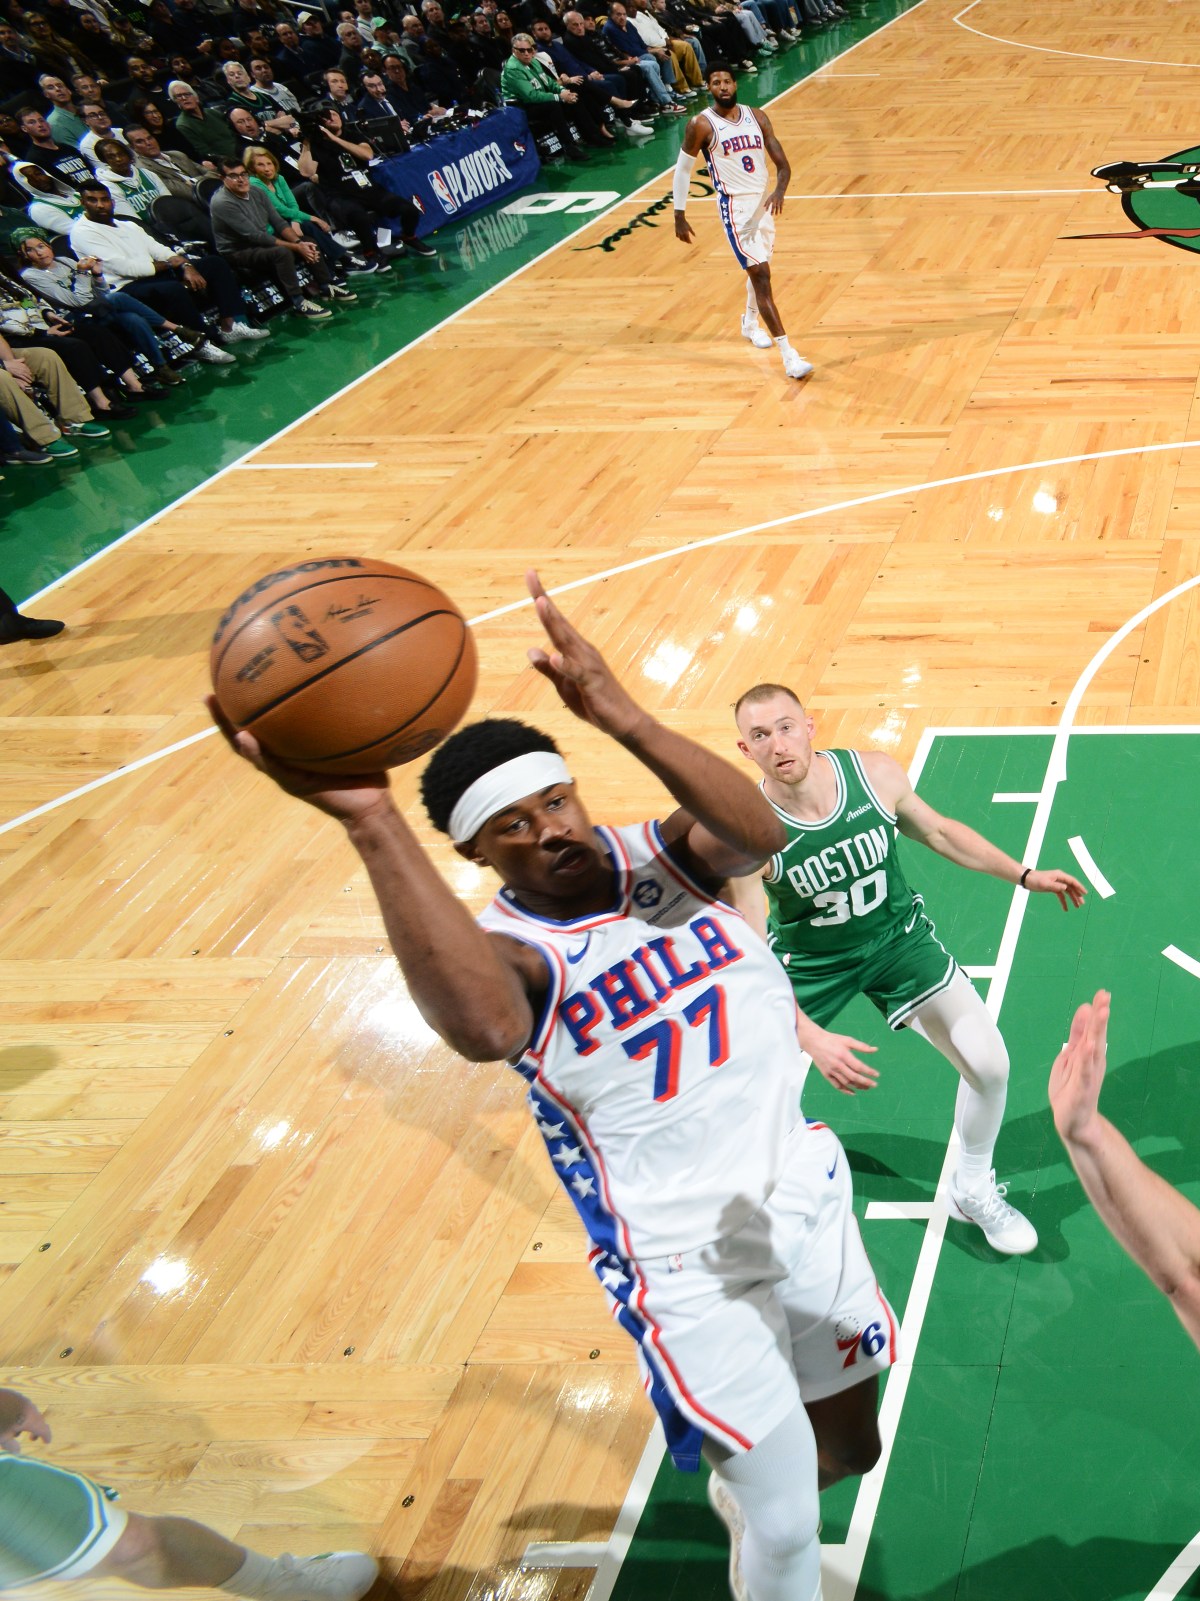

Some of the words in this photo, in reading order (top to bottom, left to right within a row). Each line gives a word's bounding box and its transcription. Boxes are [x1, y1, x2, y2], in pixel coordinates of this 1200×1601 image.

[442, 142, 513, 208] PLAYOFFS
[742, 155, 755, 174] 8
[845, 802, 873, 822] Amica
[786, 825, 889, 899] BOSTON
[810, 869, 888, 927] 30
[559, 916, 746, 1057] PHILA
[621, 984, 731, 1104] 77
[836, 1320, 887, 1370] 76
